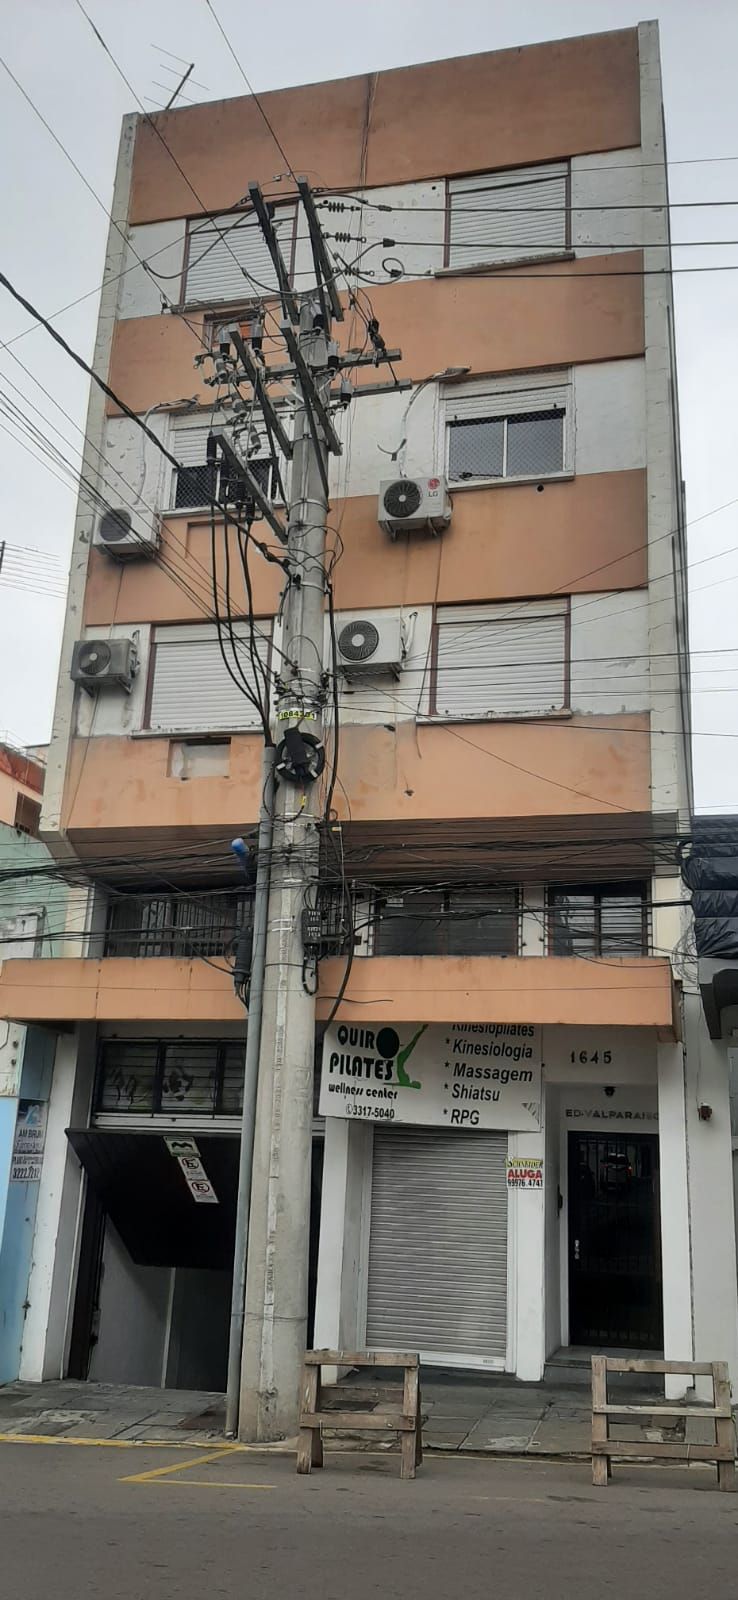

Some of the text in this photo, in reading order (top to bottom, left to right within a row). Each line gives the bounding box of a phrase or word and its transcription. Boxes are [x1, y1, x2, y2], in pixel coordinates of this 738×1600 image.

[453, 1038, 533, 1061] Kinesiologia
[570, 1050, 612, 1064] 1645
[329, 1052, 394, 1080] PILATES
[453, 1062, 533, 1084] Massagem
[328, 1082, 398, 1100] wellness center
[452, 1083, 500, 1101] Shiatsu
[353, 1104, 395, 1119] 3317-5040
[451, 1109, 480, 1125] RPG
[508, 1169, 542, 1179] ALUGA
